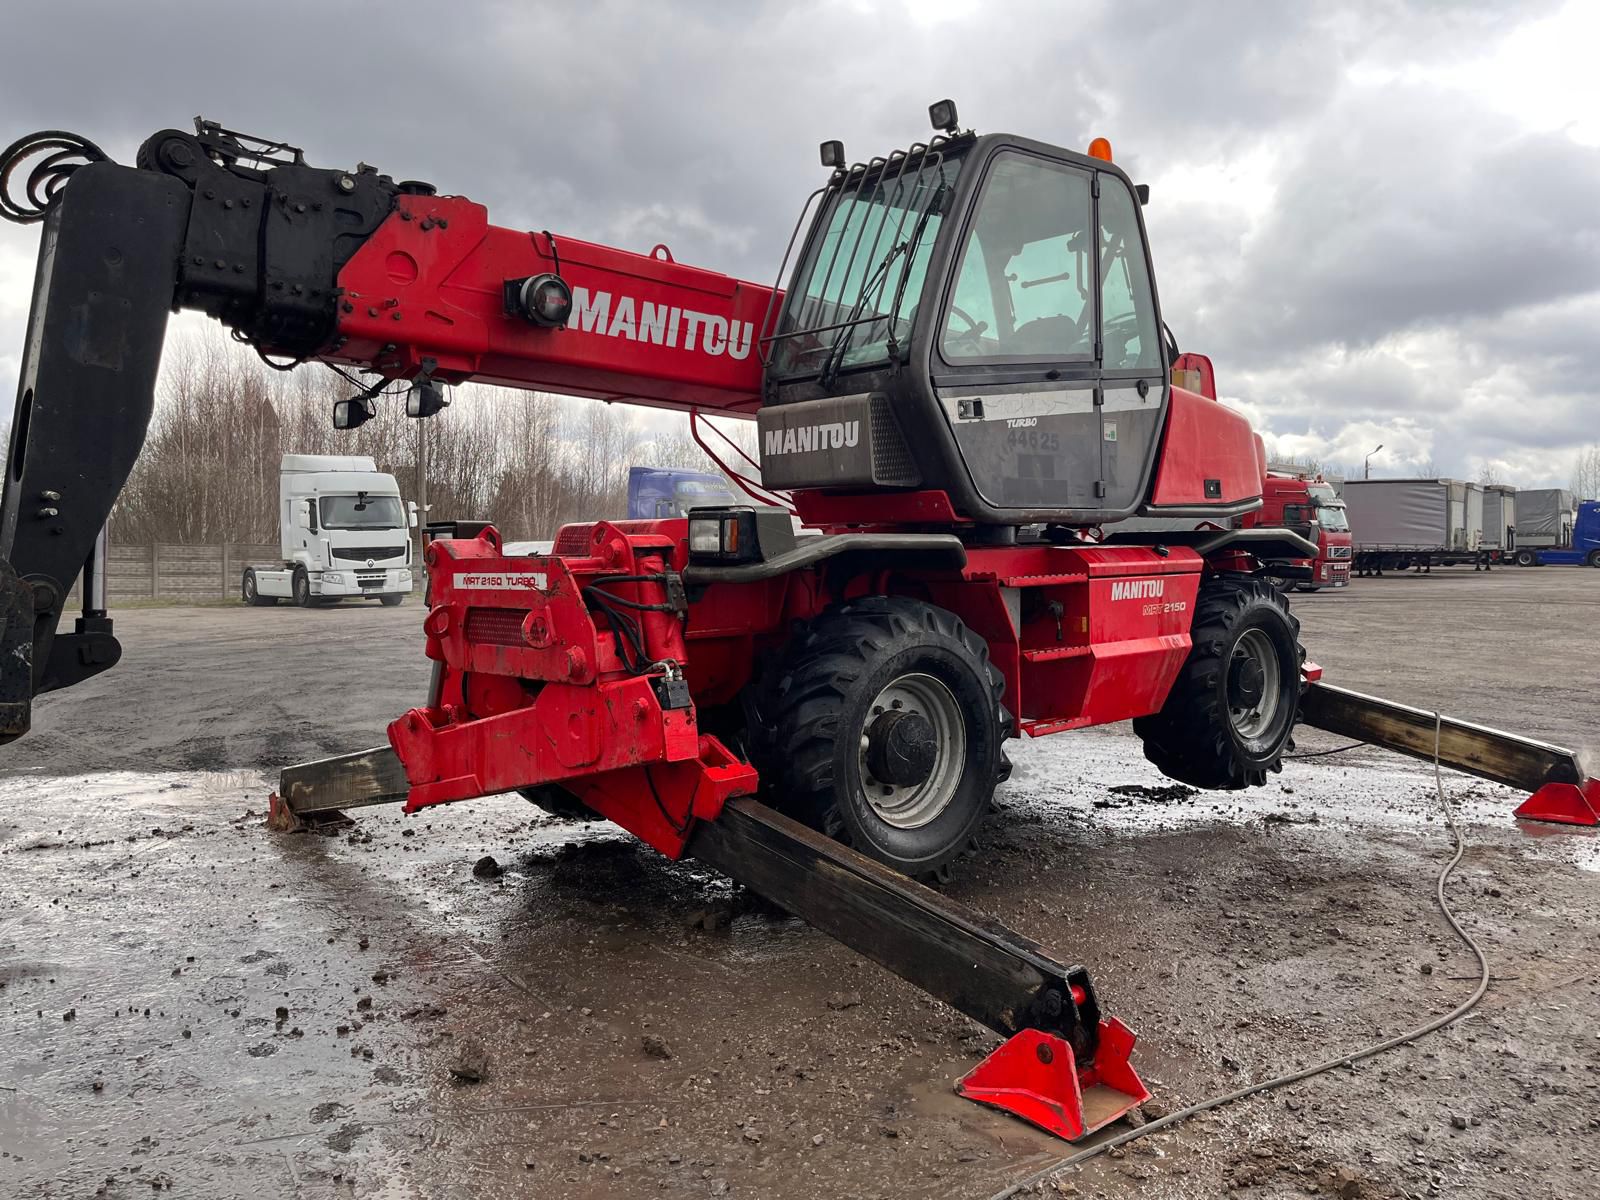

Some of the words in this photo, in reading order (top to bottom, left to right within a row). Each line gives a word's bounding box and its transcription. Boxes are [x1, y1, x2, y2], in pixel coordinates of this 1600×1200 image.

[567, 286, 754, 360] MANITOU
[1006, 417, 1037, 429] TURBO
[765, 420, 859, 456] MANITOU
[463, 577, 480, 585] MRT
[506, 576, 536, 585] TURBO
[1111, 579, 1164, 601] MANITOU
[1142, 603, 1163, 616] MRT
[1164, 601, 1186, 613] 2150
